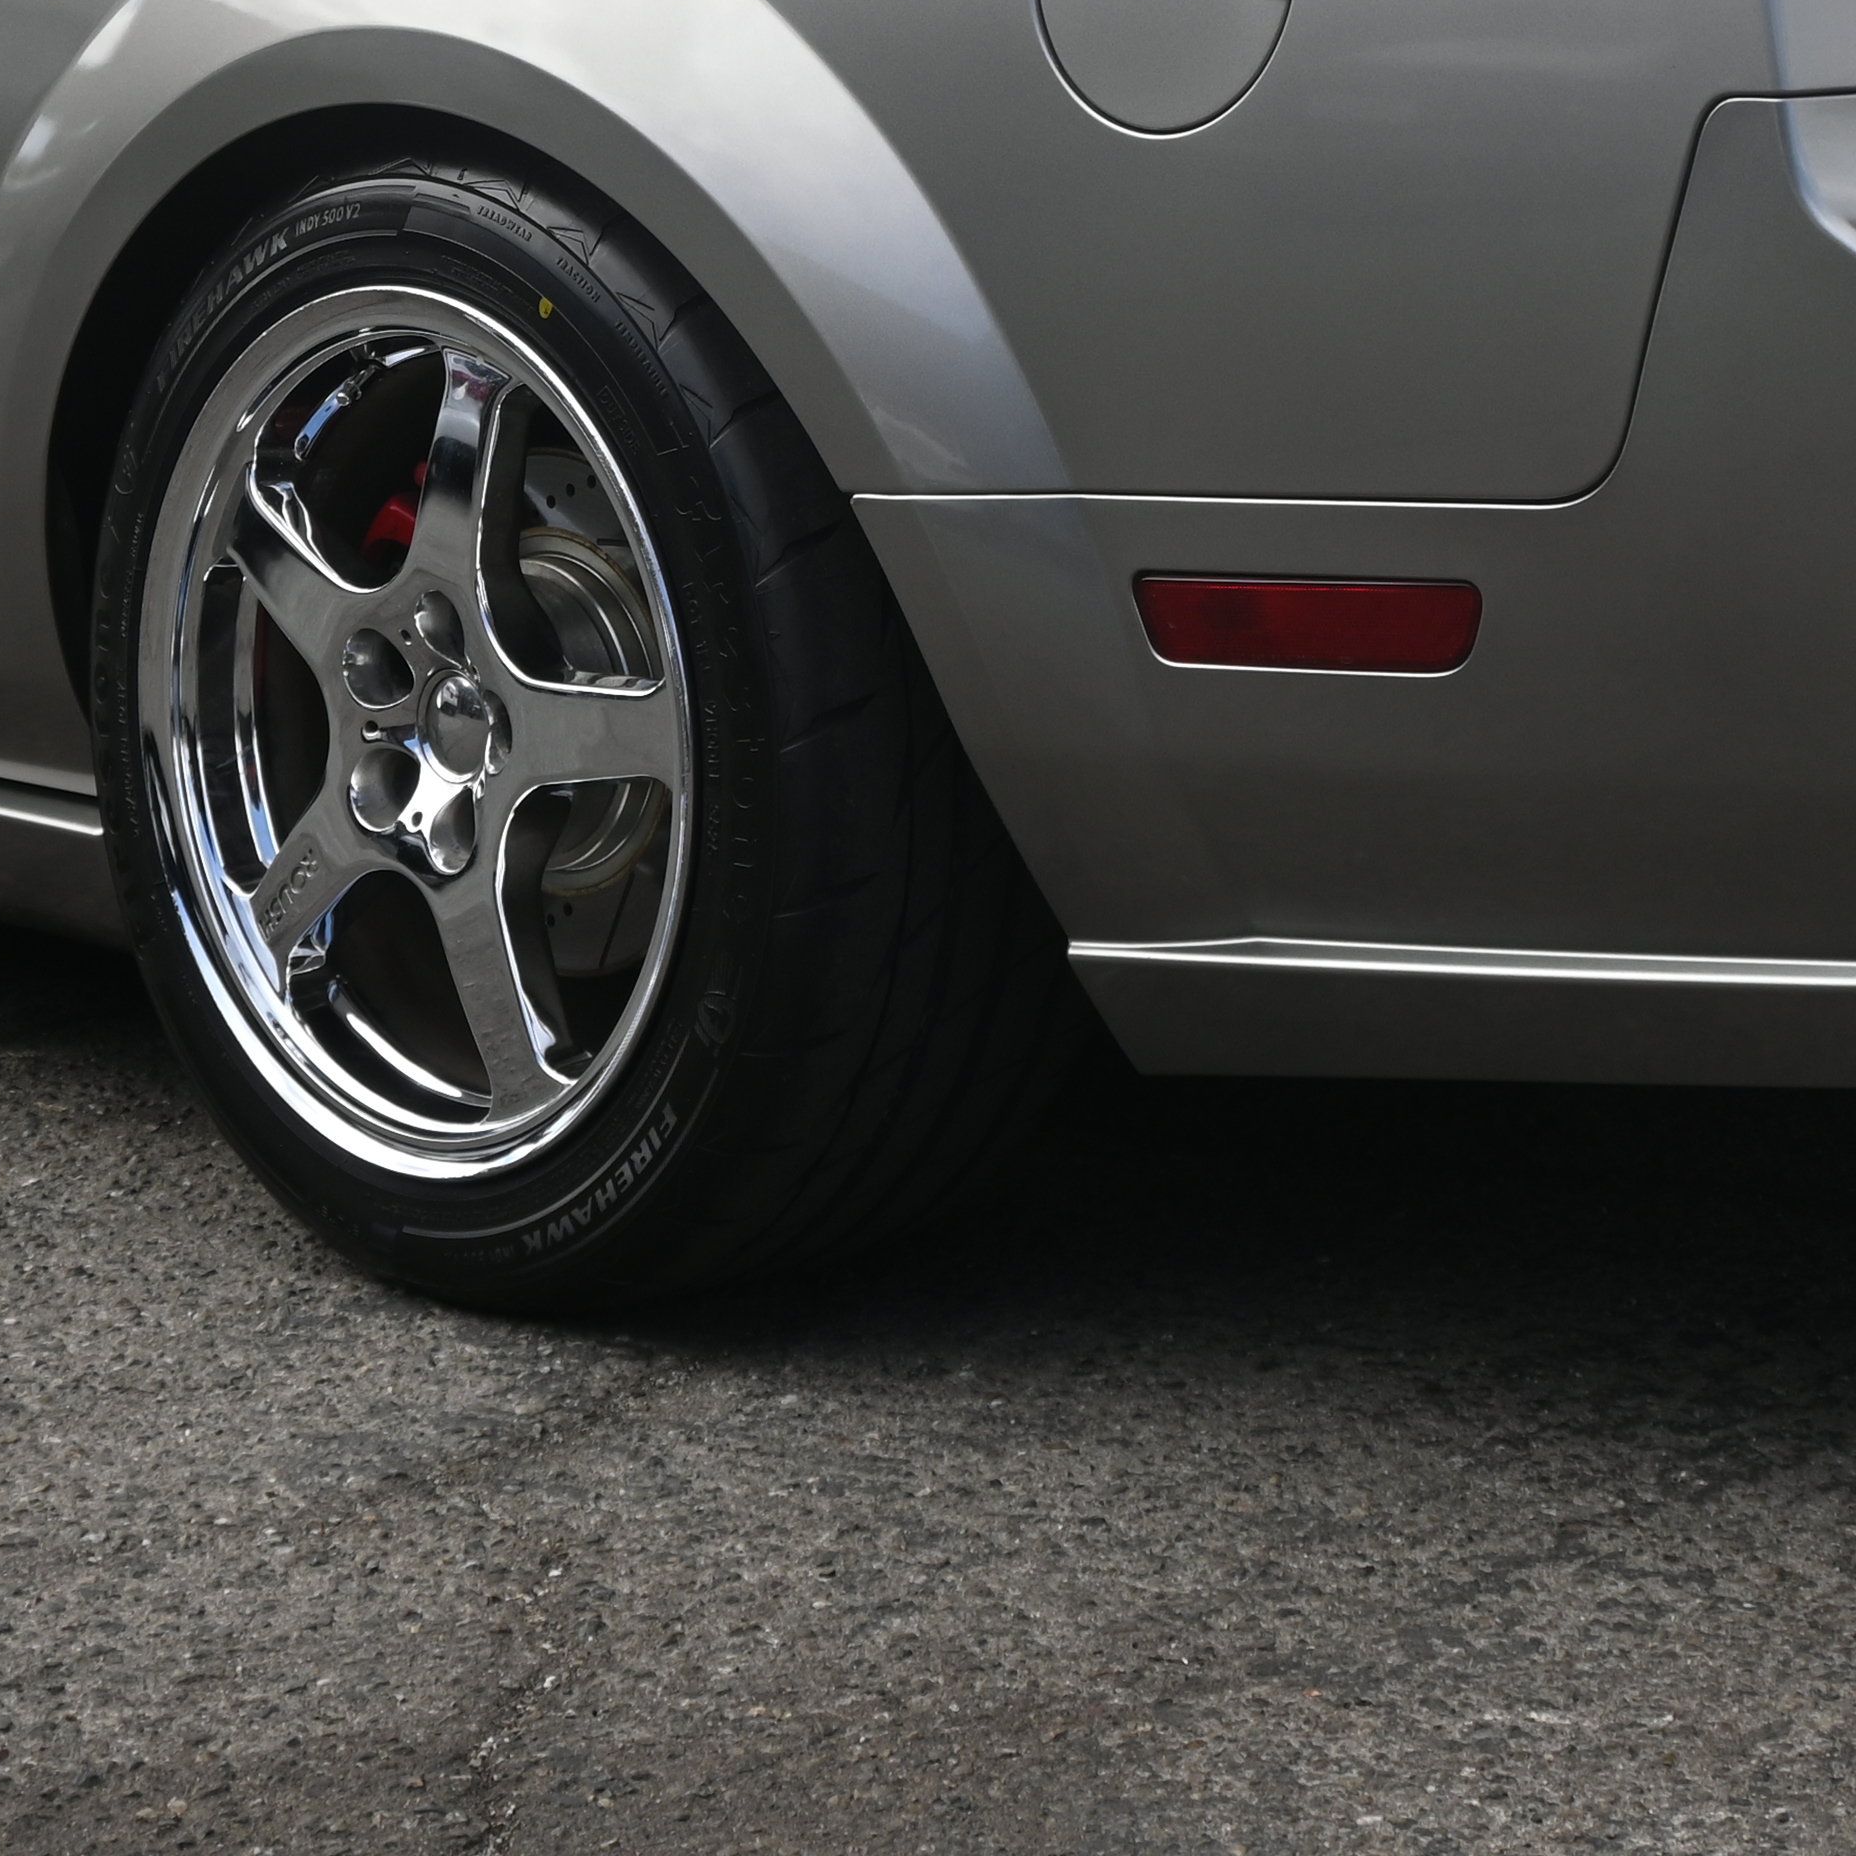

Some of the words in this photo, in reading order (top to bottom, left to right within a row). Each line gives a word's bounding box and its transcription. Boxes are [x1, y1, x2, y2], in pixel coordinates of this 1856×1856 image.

[296, 214, 321, 236] INDY
[322, 207, 345, 227] 500
[345, 202, 362, 222] V2
[477, 205, 533, 242] TREADWEAR
[554, 255, 601, 303] TRACTION
[257, 848, 319, 942] ROUSH
[520, 1102, 679, 1253] FIREHAWK
